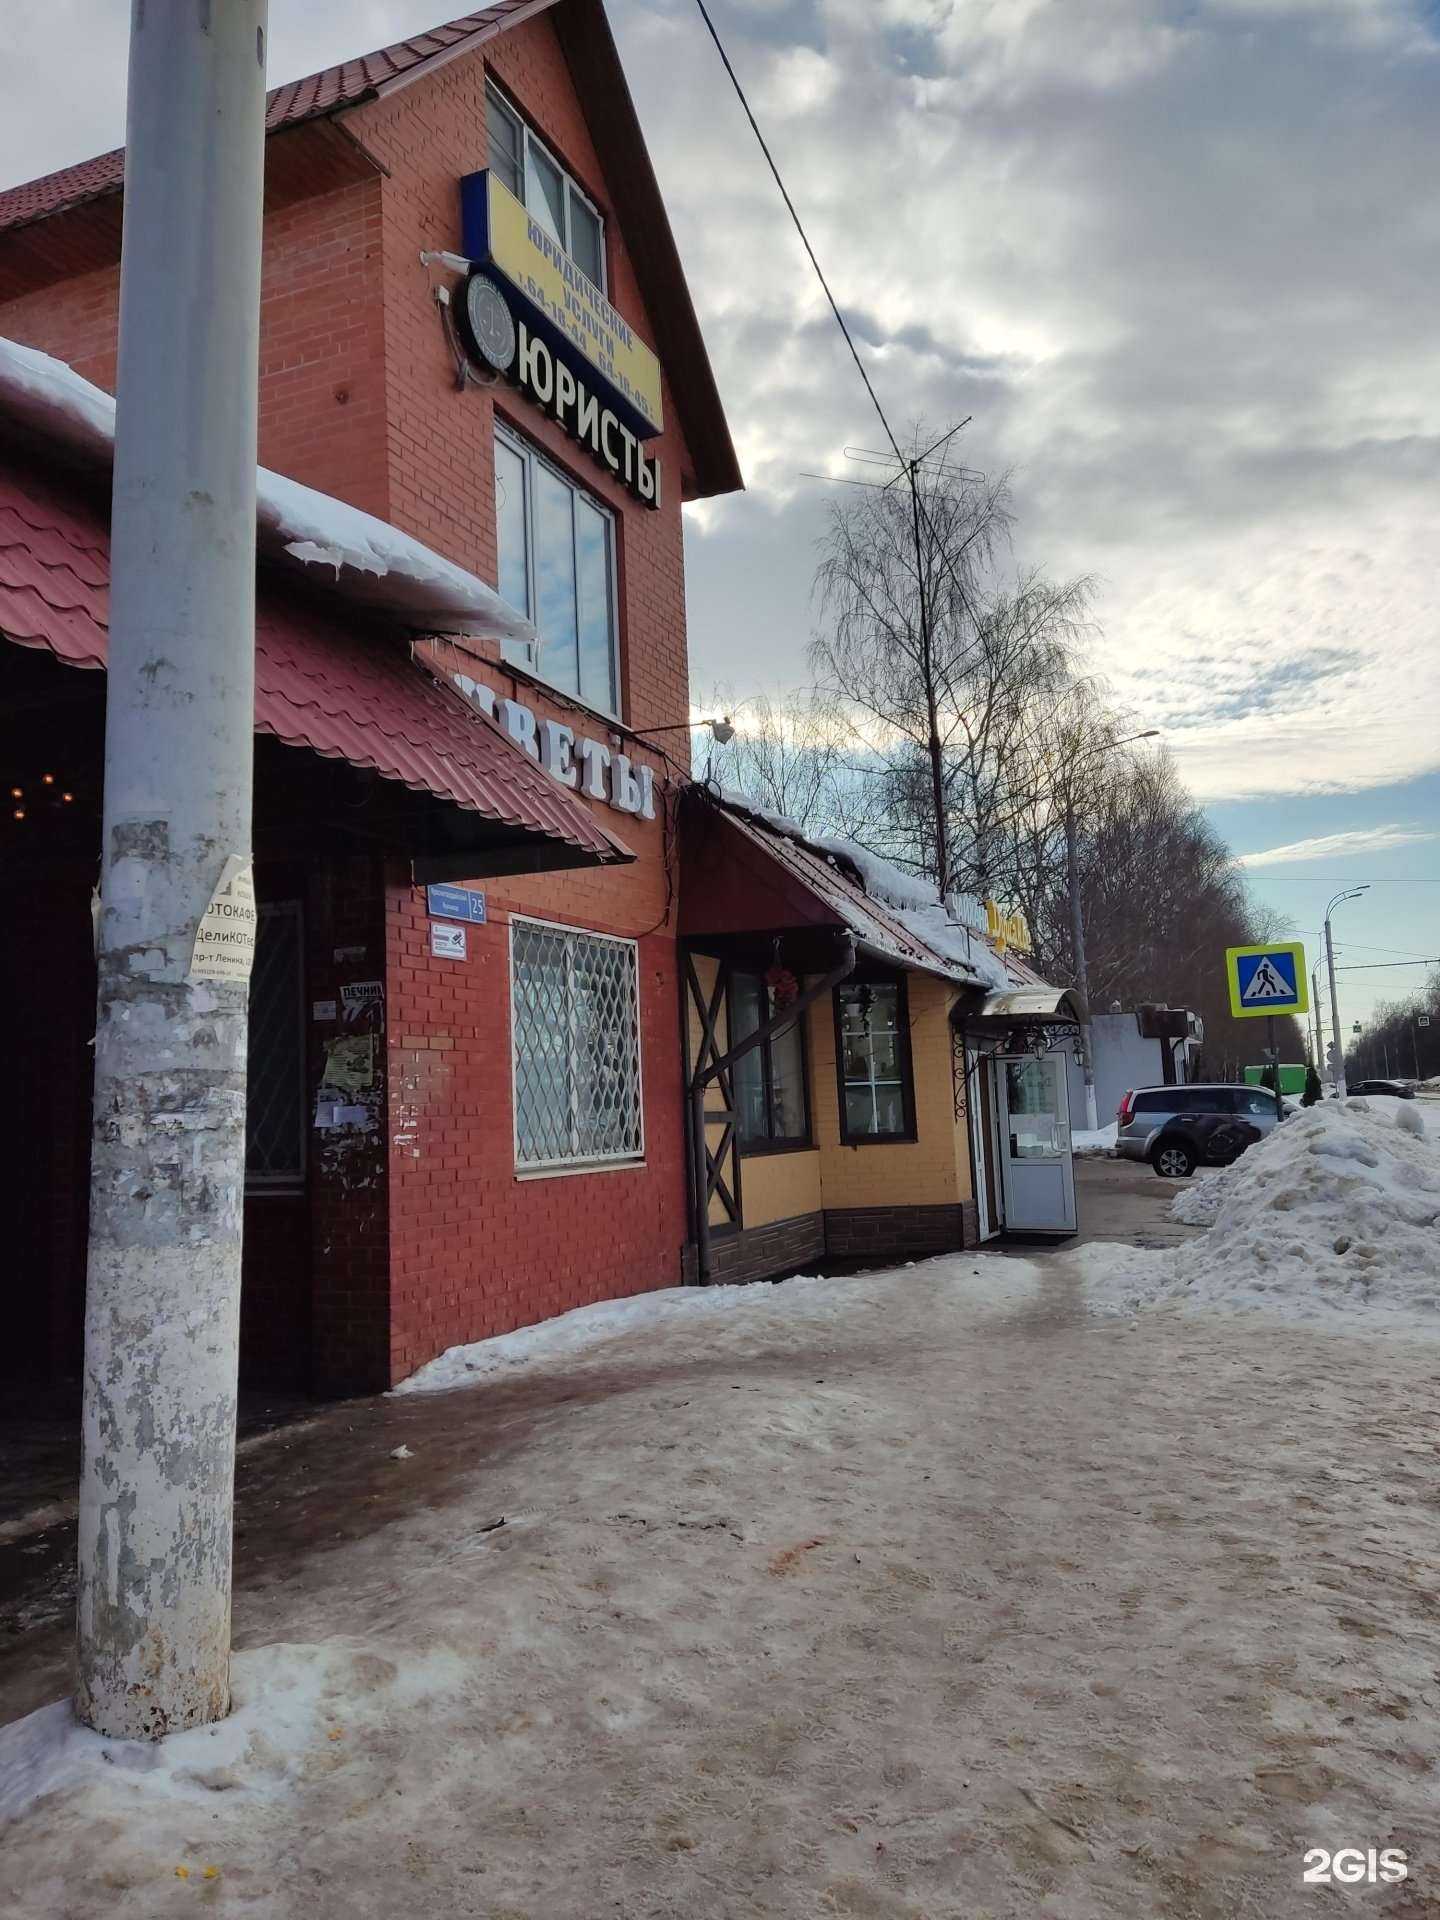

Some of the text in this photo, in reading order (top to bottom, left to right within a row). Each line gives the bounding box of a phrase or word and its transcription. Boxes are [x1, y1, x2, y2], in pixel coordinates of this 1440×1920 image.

[526, 220, 634, 352] ЮРИДИЧЕСКИЕ
[563, 283, 615, 360] УСЛУГИ
[518, 320, 662, 509] ЮРИСТЫ
[471, 897, 484, 915] 25
